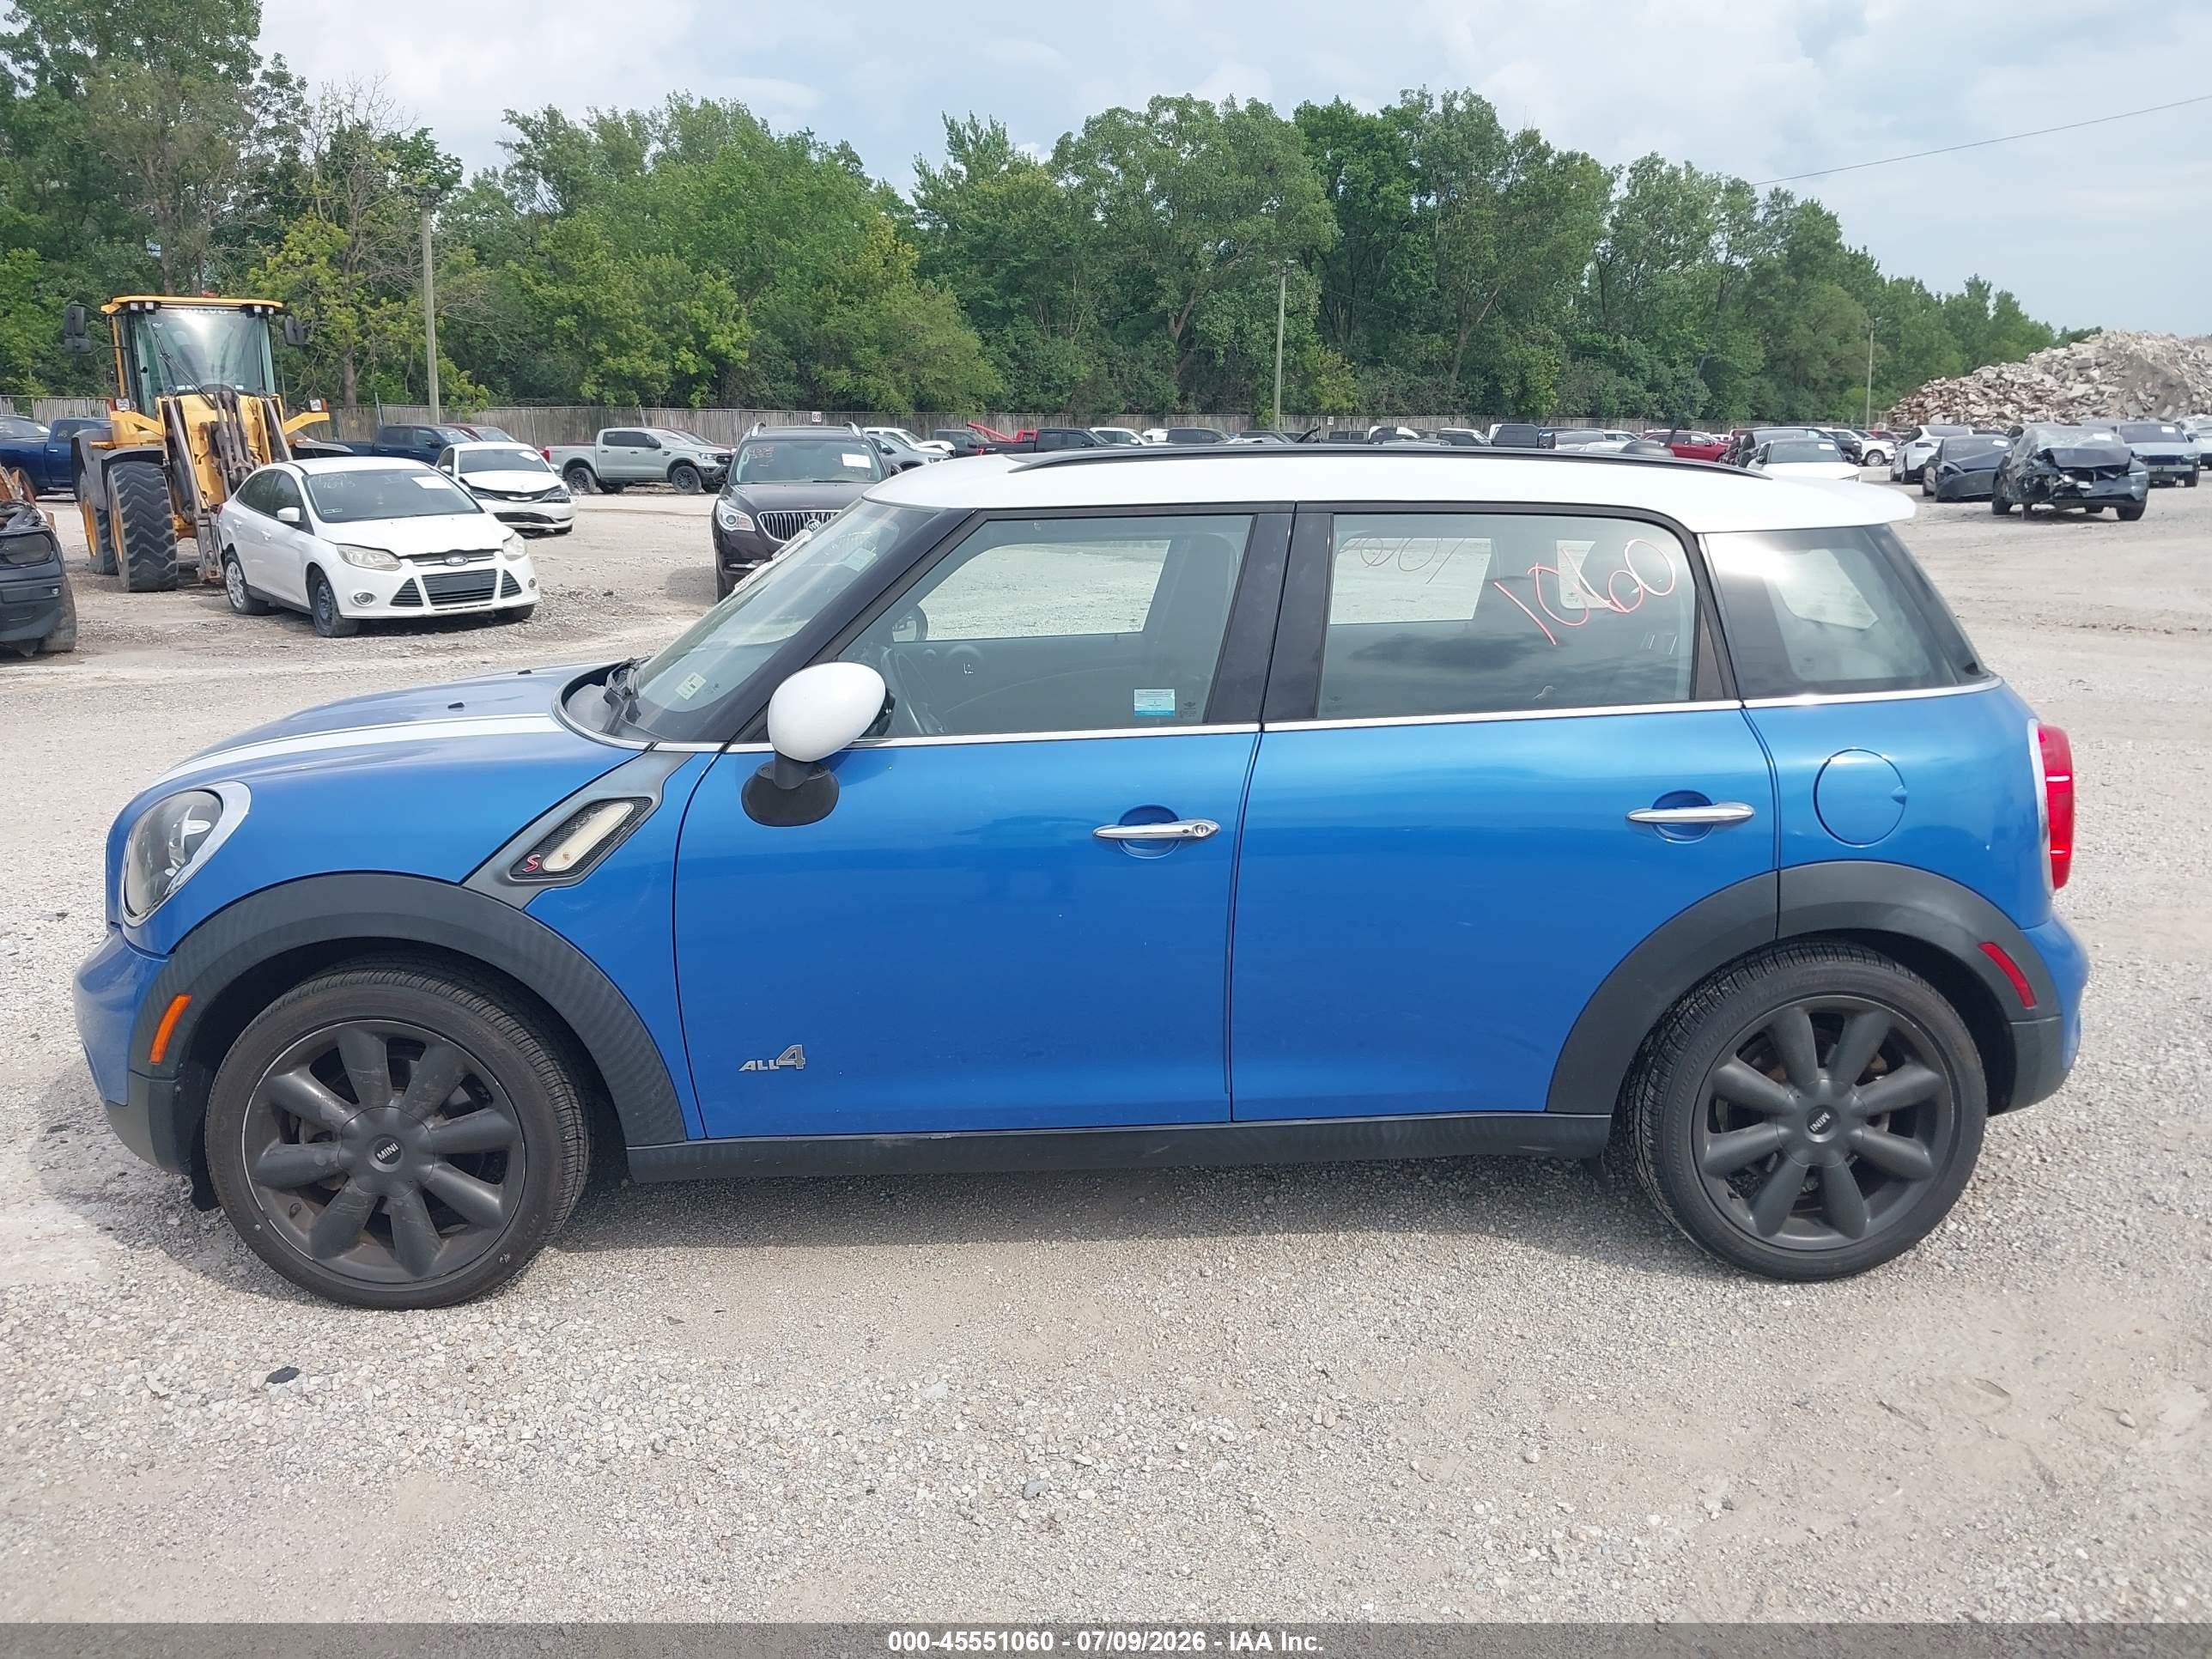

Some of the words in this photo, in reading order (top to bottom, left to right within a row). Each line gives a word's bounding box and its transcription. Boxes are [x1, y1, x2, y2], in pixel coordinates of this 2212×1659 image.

[522, 854, 541, 872] S
[1809, 1112, 1831, 1133] MINI
[376, 1142, 399, 1161] MINI
